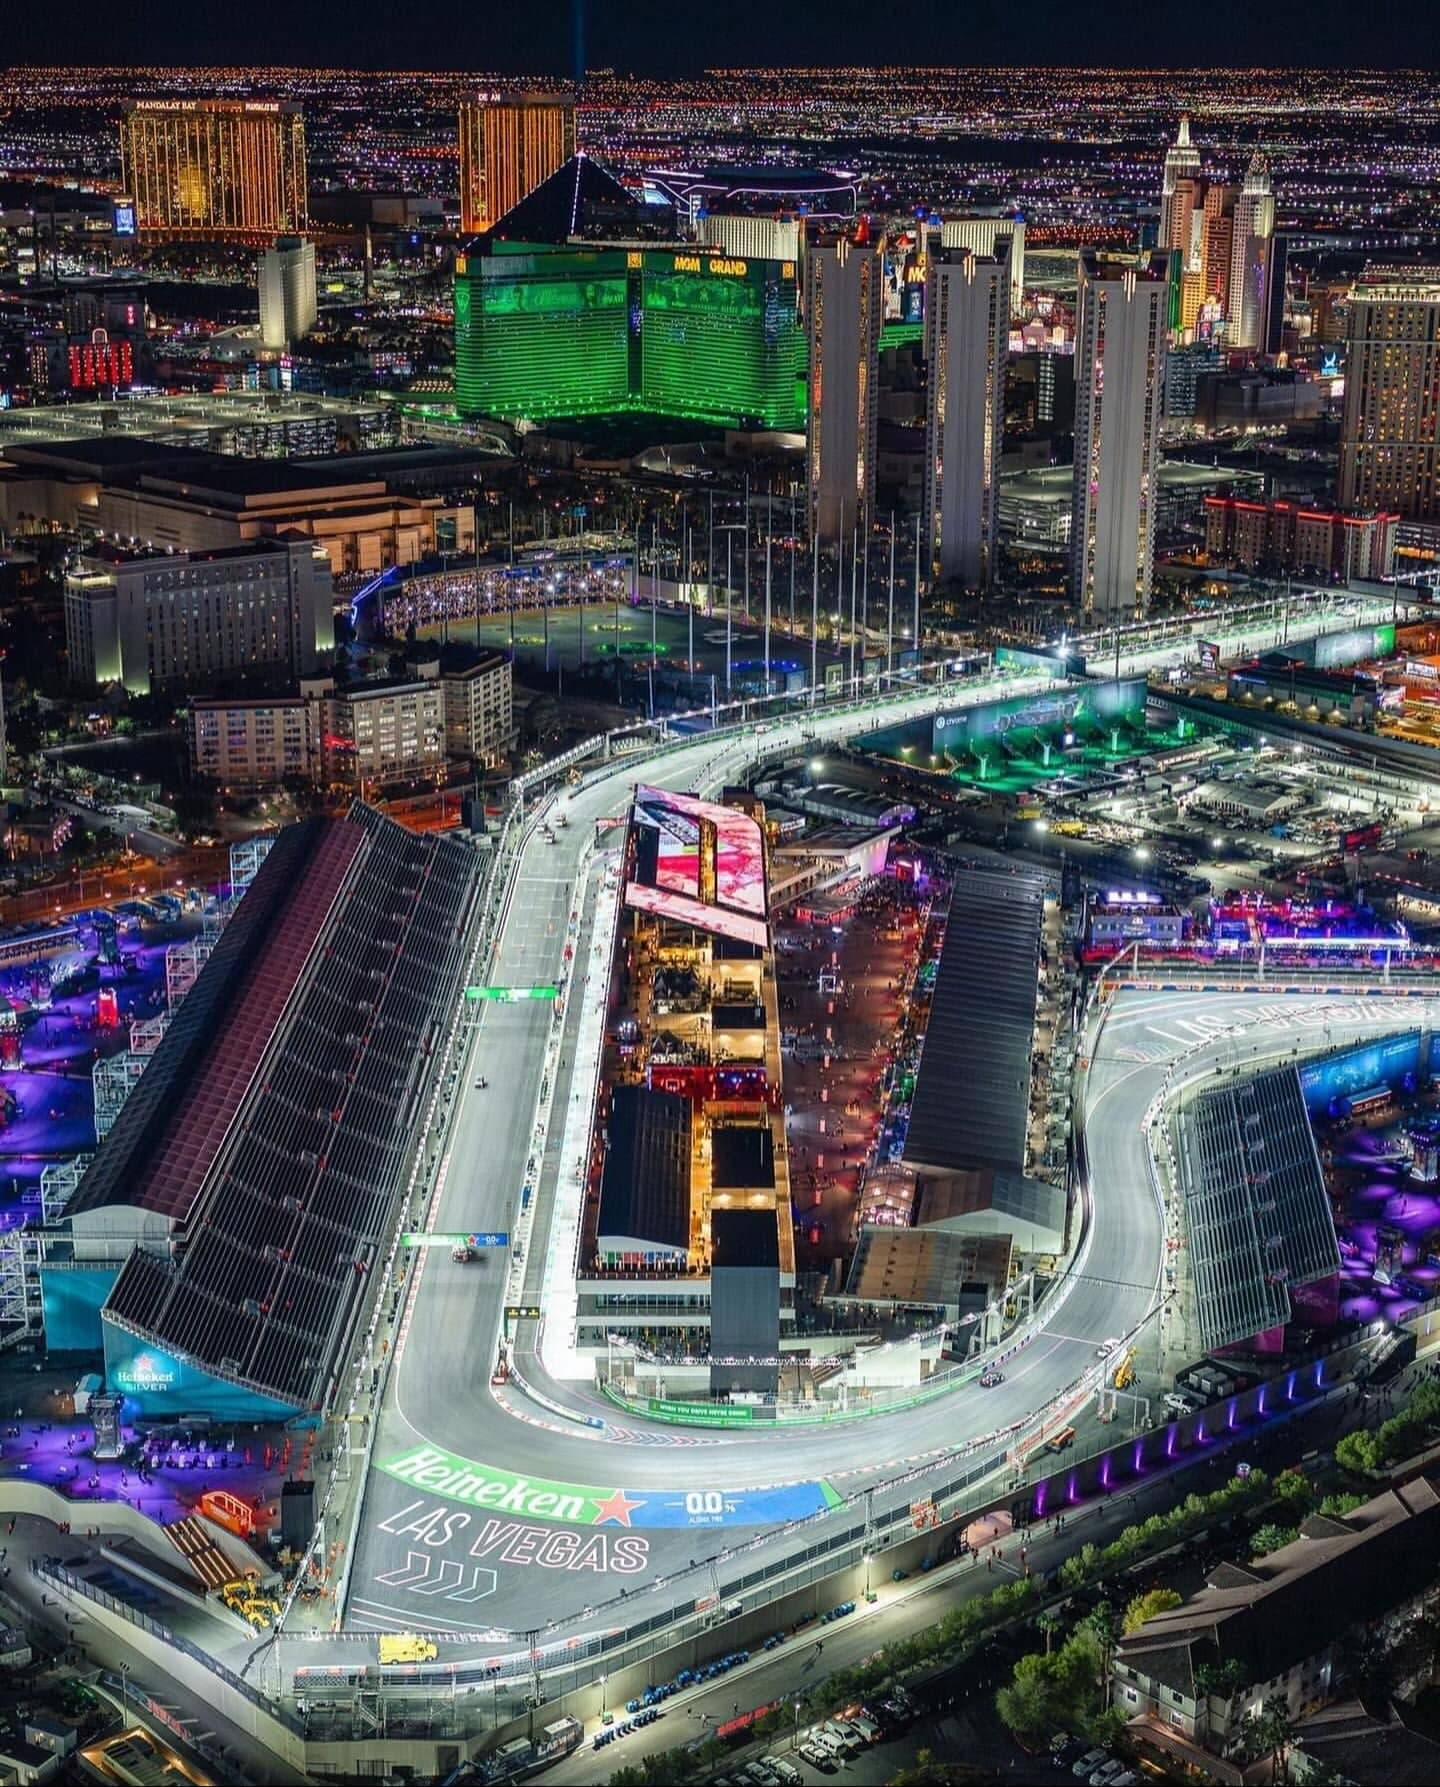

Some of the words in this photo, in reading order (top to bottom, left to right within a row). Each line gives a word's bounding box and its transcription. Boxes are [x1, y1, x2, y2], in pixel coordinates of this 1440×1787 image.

[136, 101, 180, 110] MANDALAY
[182, 101, 197, 110] BAY
[675, 257, 700, 272] MGM
[709, 259, 747, 276] GRAND
[118, 1370, 174, 1382] Heineken
[126, 1383, 167, 1391] SILVER
[385, 1449, 585, 1520] Heineken
[377, 1500, 471, 1546] LAS
[470, 1519, 649, 1572] VEGAS
